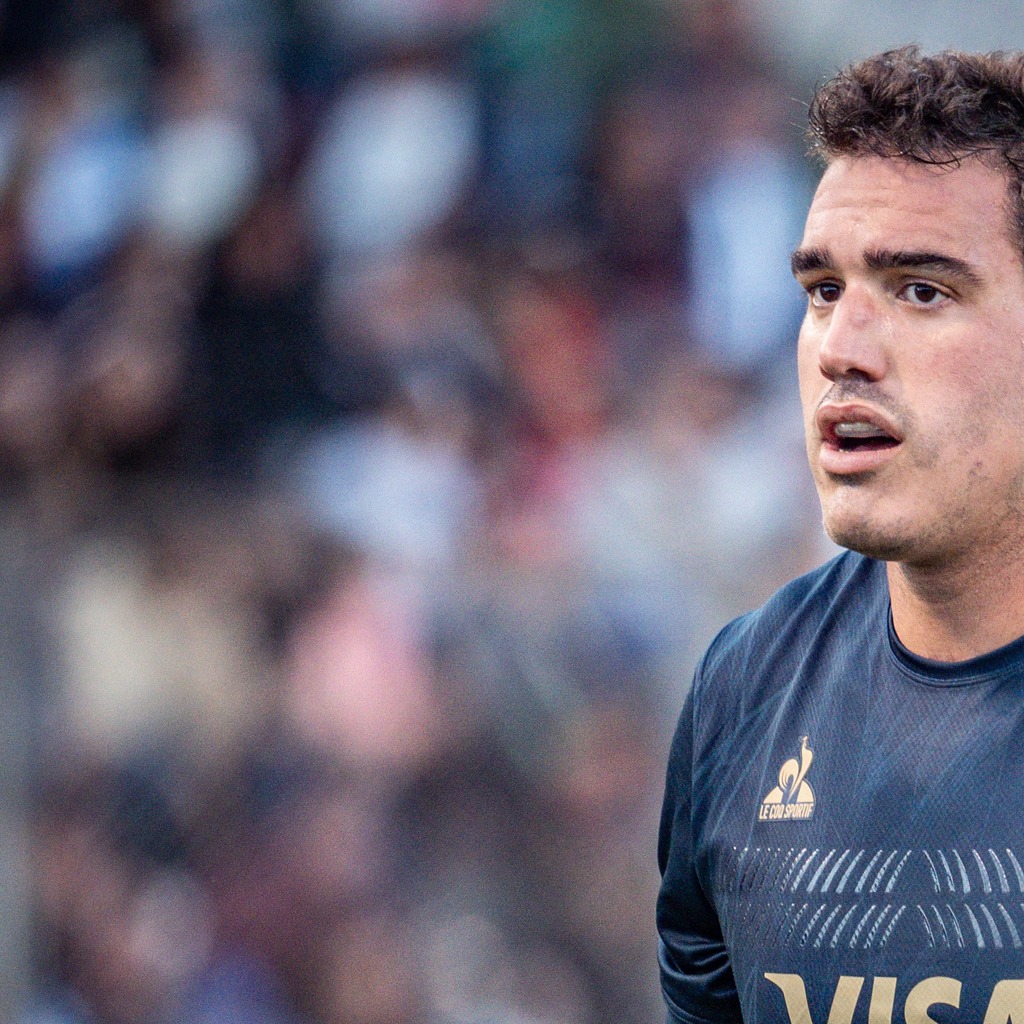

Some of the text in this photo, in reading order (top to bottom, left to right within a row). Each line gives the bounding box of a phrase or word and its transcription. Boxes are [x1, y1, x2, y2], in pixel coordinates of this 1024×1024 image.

[759, 803, 814, 819] LE COQ SPORTIF
